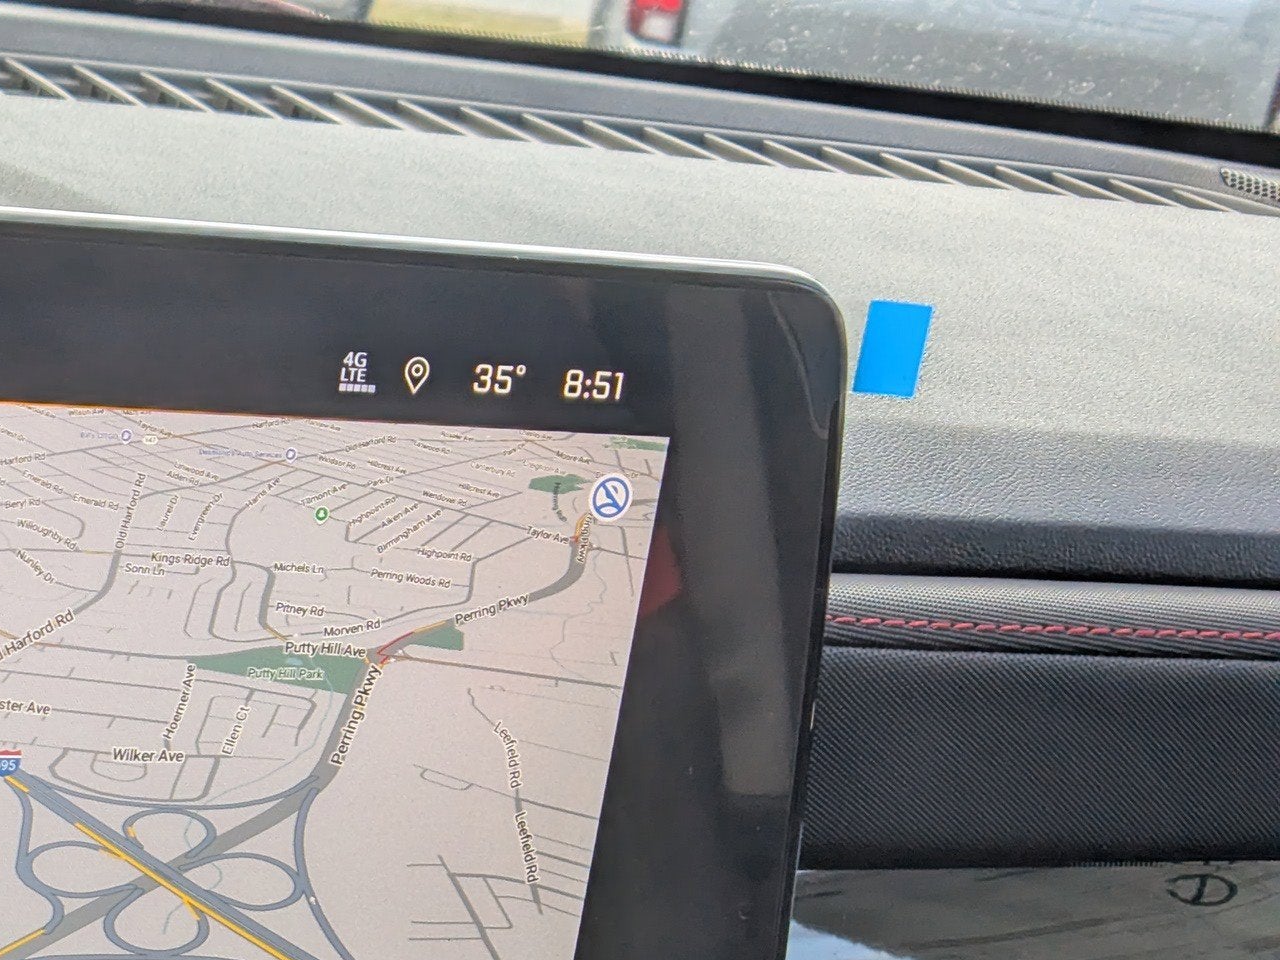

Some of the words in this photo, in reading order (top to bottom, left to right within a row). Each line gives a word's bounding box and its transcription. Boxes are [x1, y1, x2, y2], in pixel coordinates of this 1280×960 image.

[343, 351, 368, 367] 4G
[340, 367, 366, 384] LTE
[473, 363, 527, 394] 35°
[563, 369, 624, 400] 8:51
[53, 485, 64, 494] Rd
[30, 498, 41, 506] Rd
[73, 493, 106, 507] Emerald
[108, 502, 119, 511] Rd
[115, 531, 127, 549] Old
[121, 490, 140, 529] Harford
[138, 473, 147, 488] Rd
[404, 502, 419, 515] Ave
[157, 503, 175, 531] Laurel
[189, 500, 217, 541] Evergreen
[17, 519, 62, 543] Willoughby
[64, 539, 77, 550] Rd
[377, 521, 425, 553] Birmingham
[426, 509, 441, 522] Ave
[527, 525, 551, 540] Taylor
[553, 533, 569, 543] Ave
[17, 551, 42, 575] Nunley
[151, 552, 180, 565] Kings
[183, 554, 213, 567] Ridge
[216, 556, 229, 566] Rd
[460, 551, 471, 562] Rd
[125, 563, 150, 574] Sonn
[153, 565, 165, 575] Ln
[274, 564, 309, 573] Michels
[312, 565, 324, 573] Ln
[371, 569, 403, 582] Perring
[406, 573, 435, 586] Woods
[438, 578, 451, 588] Rd
[276, 603, 308, 616] Pitney
[310, 606, 324, 617] Rd
[455, 605, 495, 624] Perring
[499, 594, 529, 611] Pkwy
[5, 625, 53, 655] Harford
[56, 610, 74, 625] Rd
[324, 625, 364, 637] Morven
[366, 619, 380, 631] Rd
[285, 642, 317, 656] Putty
[322, 643, 341, 655] Hill
[345, 645, 366, 657] Ave
[248, 669, 277, 680] Putty
[280, 669, 296, 679] Hill
[300, 669, 322, 680] Park
[27, 702, 50, 715] Ave
[163, 691, 190, 739] Hoerner
[183, 664, 195, 688] Ave
[330, 708, 365, 765] Perring
[354, 665, 382, 708] Pkwy
[222, 723, 242, 755] Ellen
[236, 706, 250, 721] Ct
[113, 748, 155, 762] Wilker
[159, 750, 184, 762] Ave
[494, 721, 520, 767] Leefield
[510, 770, 522, 789] Rd
[515, 811, 537, 863] Leefield
[526, 866, 538, 884] Rd
